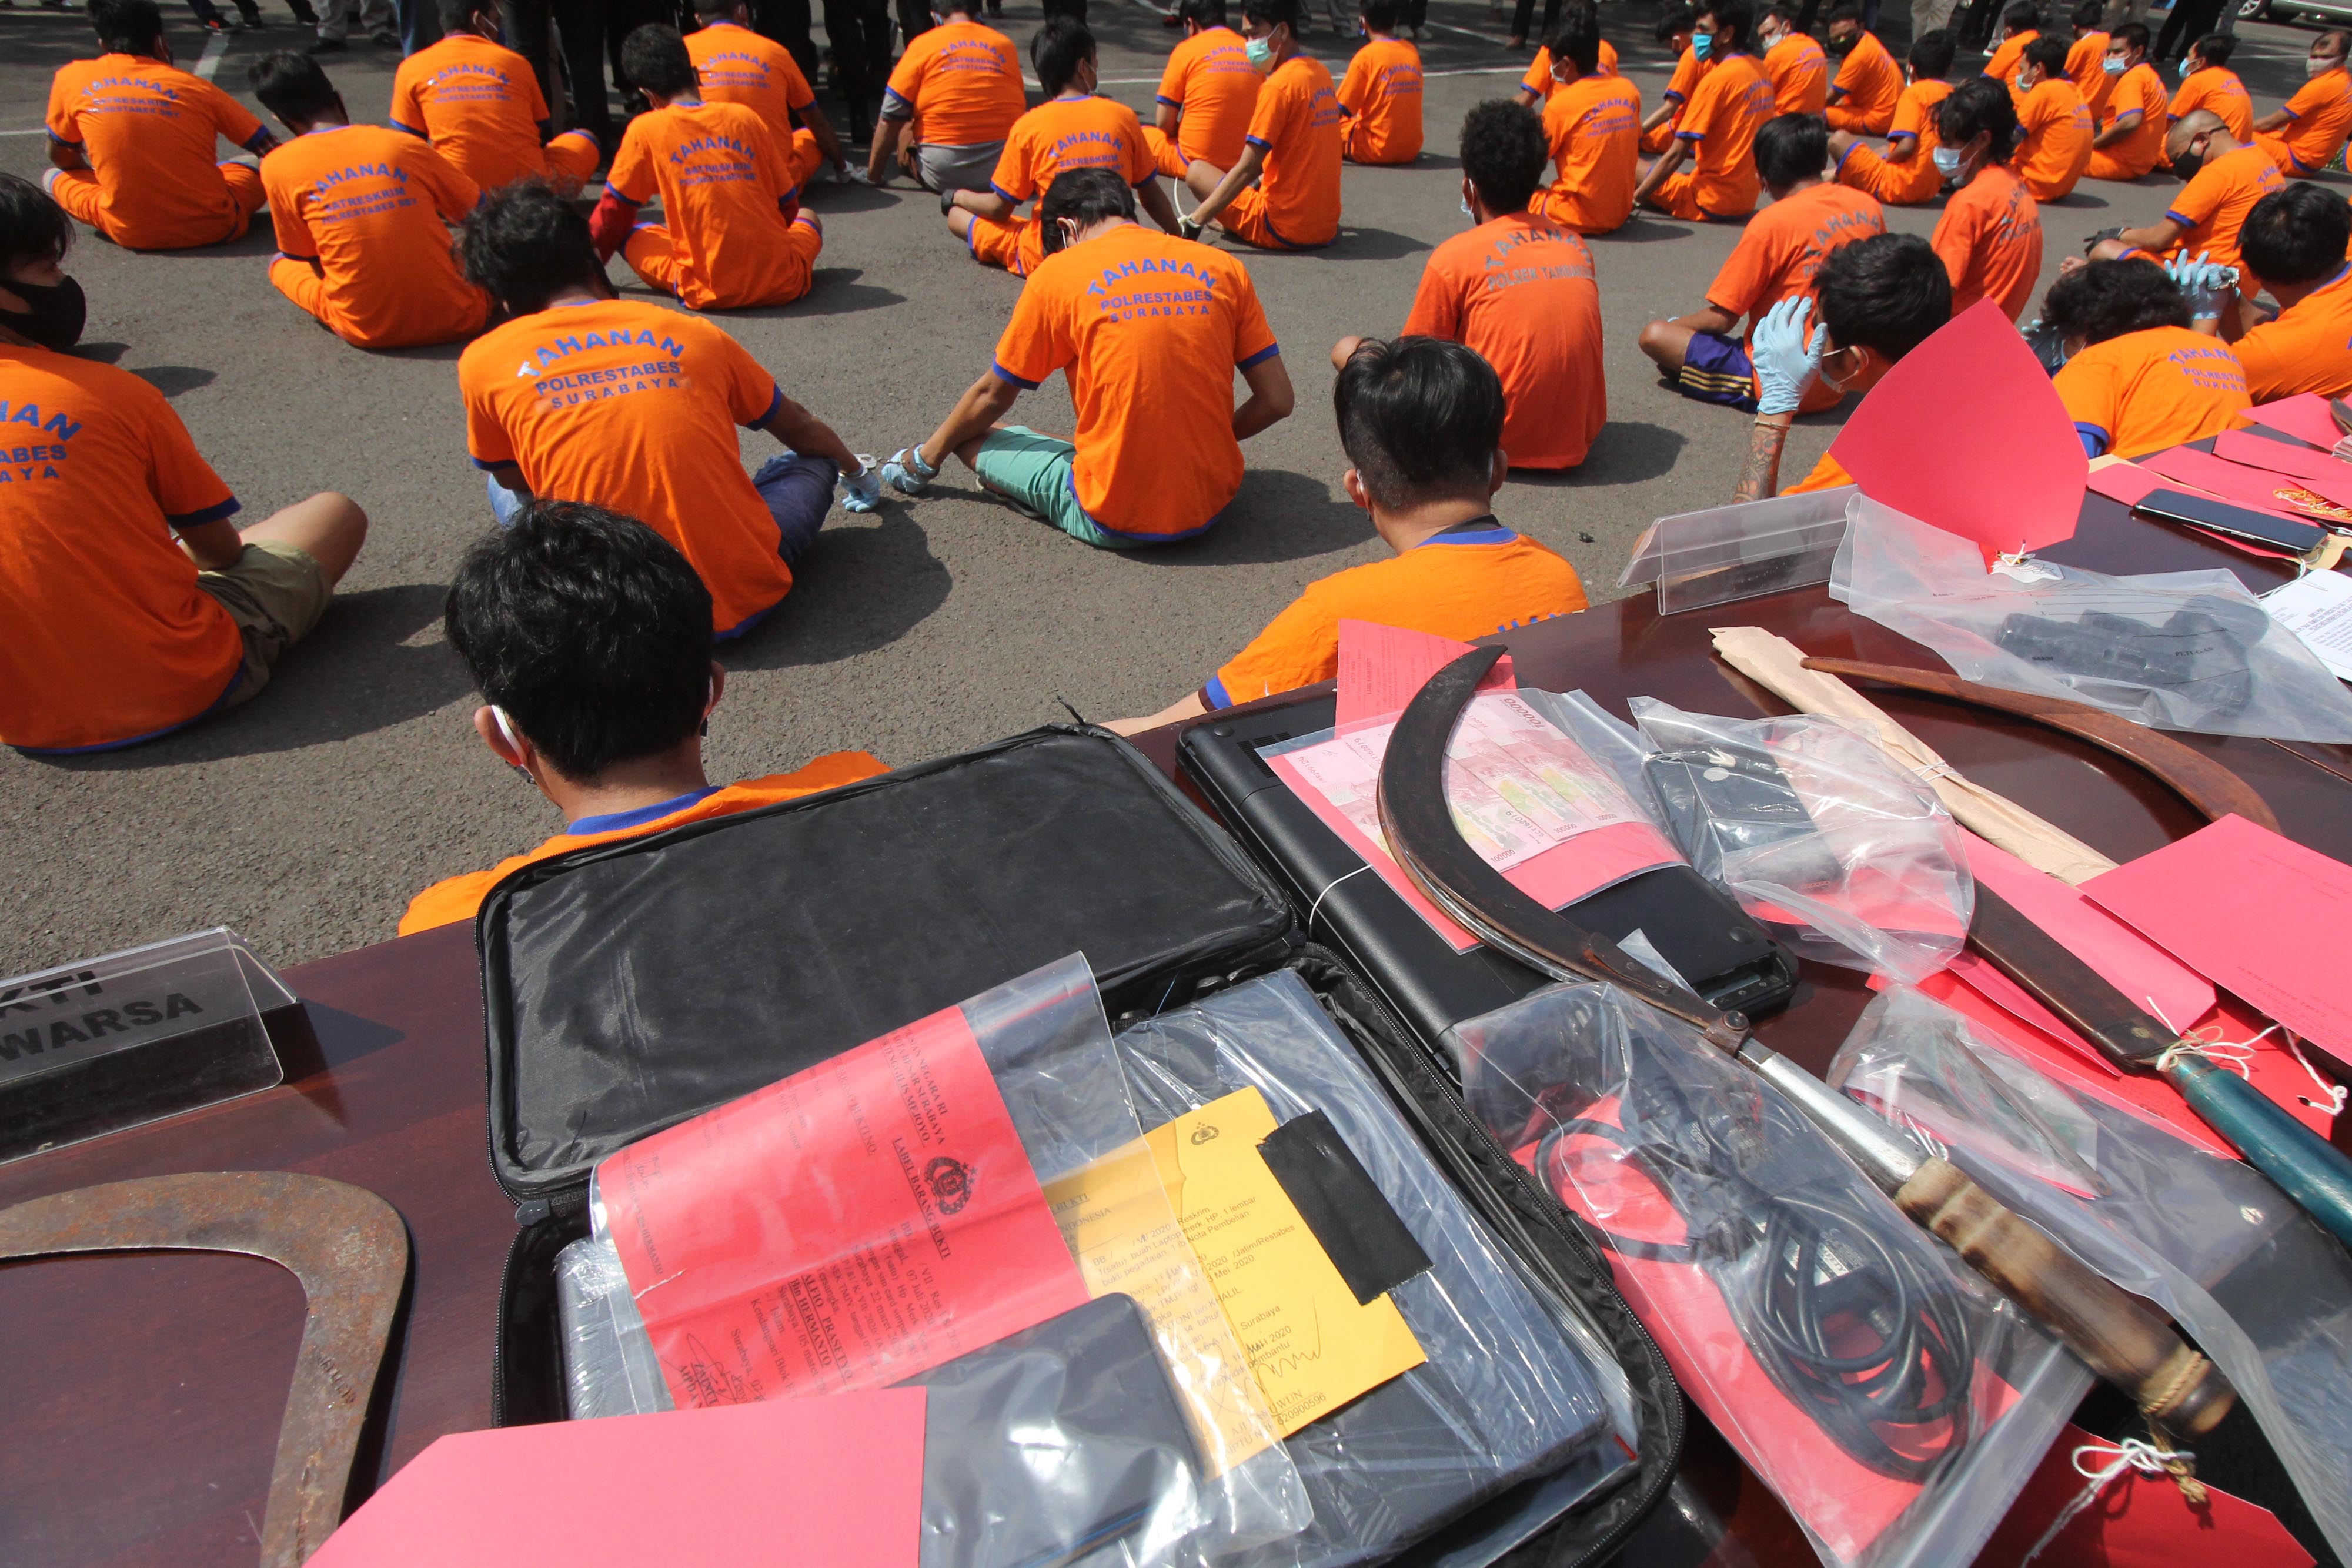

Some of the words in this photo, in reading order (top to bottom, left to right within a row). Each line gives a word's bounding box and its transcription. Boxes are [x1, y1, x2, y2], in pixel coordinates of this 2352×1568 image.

[82, 77, 179, 100] TAHANAN
[427, 64, 511, 85] TAHANAN
[670, 136, 756, 164] TAHANAN
[1049, 131, 1122, 158] TAHANAN
[1059, 154, 1118, 168] SATRESKRIM
[308, 163, 409, 202] TAHANAN
[1087, 258, 1217, 296] TAHANAN
[1488, 268, 1539, 292] POLSEK
[1101, 290, 1213, 311] POLRESTABES
[1110, 305, 1210, 323] SURABAYA
[517, 329, 684, 377] TAHANAN
[536, 361, 680, 396] POLRESTABES
[552, 377, 678, 409] SURABAYA
[1491, 848, 1516, 863] 100000
[903, 1095, 931, 1142] MEJOYO
[914, 1086, 947, 1145] SURABAYA
[936, 1101, 948, 1115] RI
[891, 1137, 917, 1176] LABEL
[908, 1174, 936, 1222] BARANG
[928, 1222, 952, 1259] BUKTI
[1151, 1228, 1182, 1251] Laptop
[1228, 1193, 1258, 1214] lembar
[1185, 1229, 1207, 1245] Nota
[1205, 1255, 1229, 1272] 2020
[1214, 1266, 1232, 1281] Mei
[1232, 1253, 1256, 1271] 2020
[801, 1272, 825, 1309] ALFIO
[795, 1297, 835, 1367] HERMANTO
[1268, 1325, 1293, 1343] 2020
[1246, 1340, 1292, 1370] pembantu
